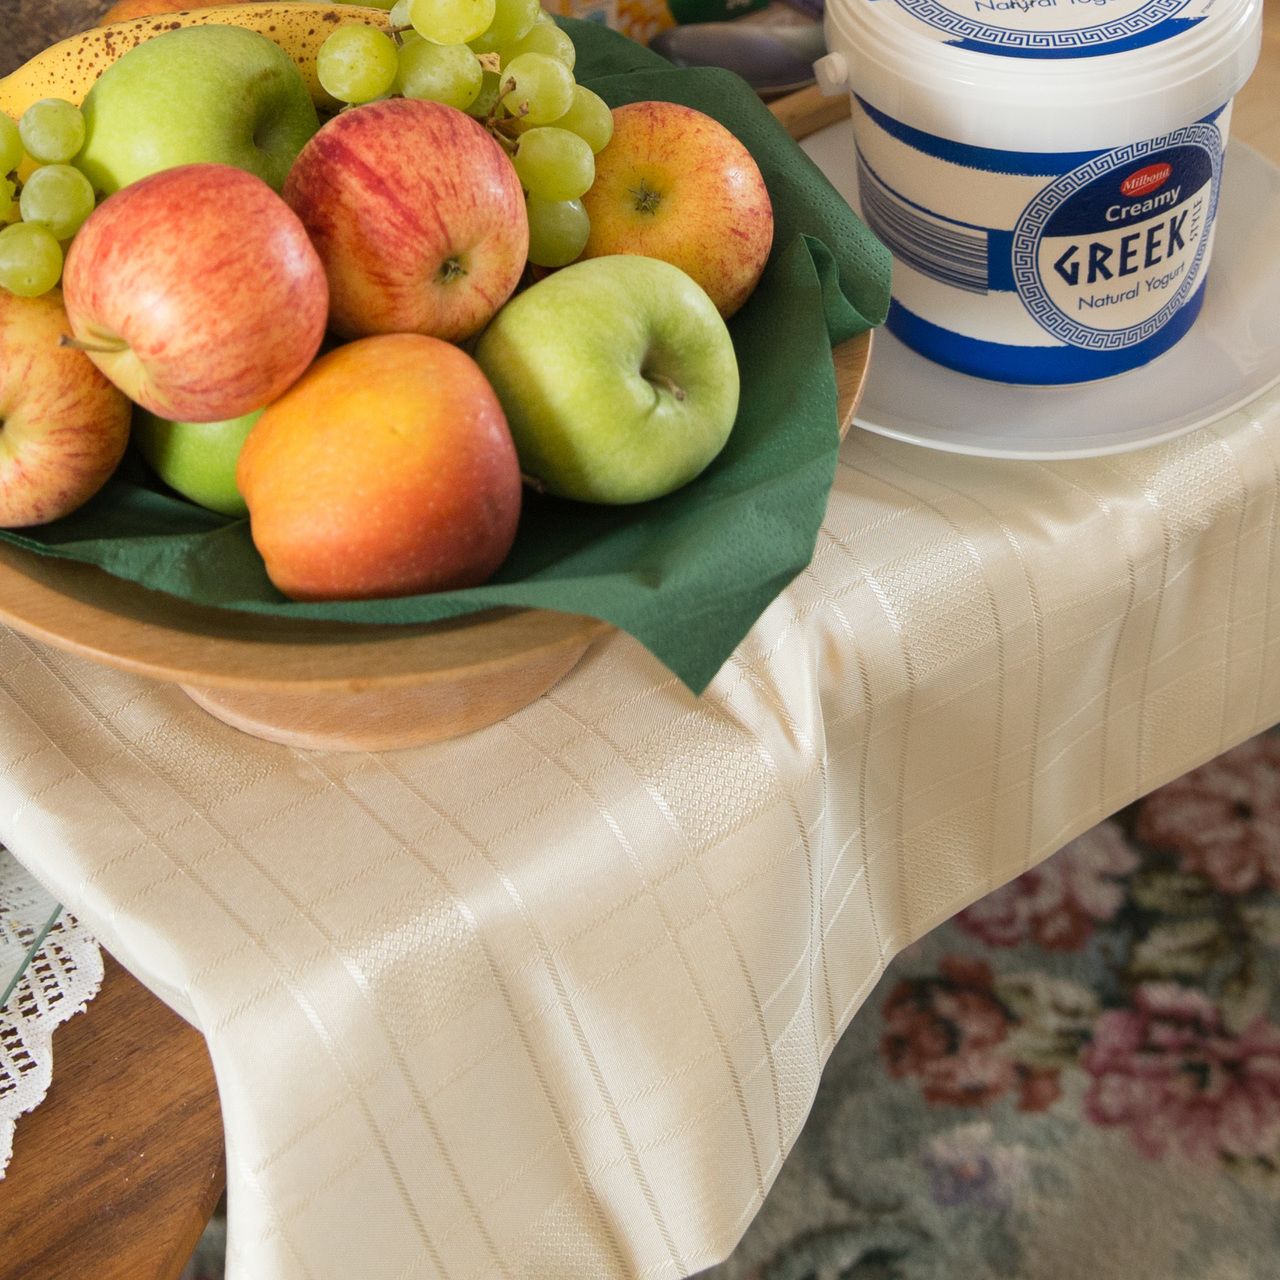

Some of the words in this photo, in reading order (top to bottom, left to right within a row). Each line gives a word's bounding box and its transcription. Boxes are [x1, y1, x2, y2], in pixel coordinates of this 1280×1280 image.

[1122, 167, 1170, 192] Milbona
[1105, 184, 1181, 223] Creamy
[1054, 209, 1188, 286] GREEK
[1189, 196, 1203, 242] STYLE
[1078, 281, 1140, 311] Natural
[1145, 261, 1186, 292] Yogurt
